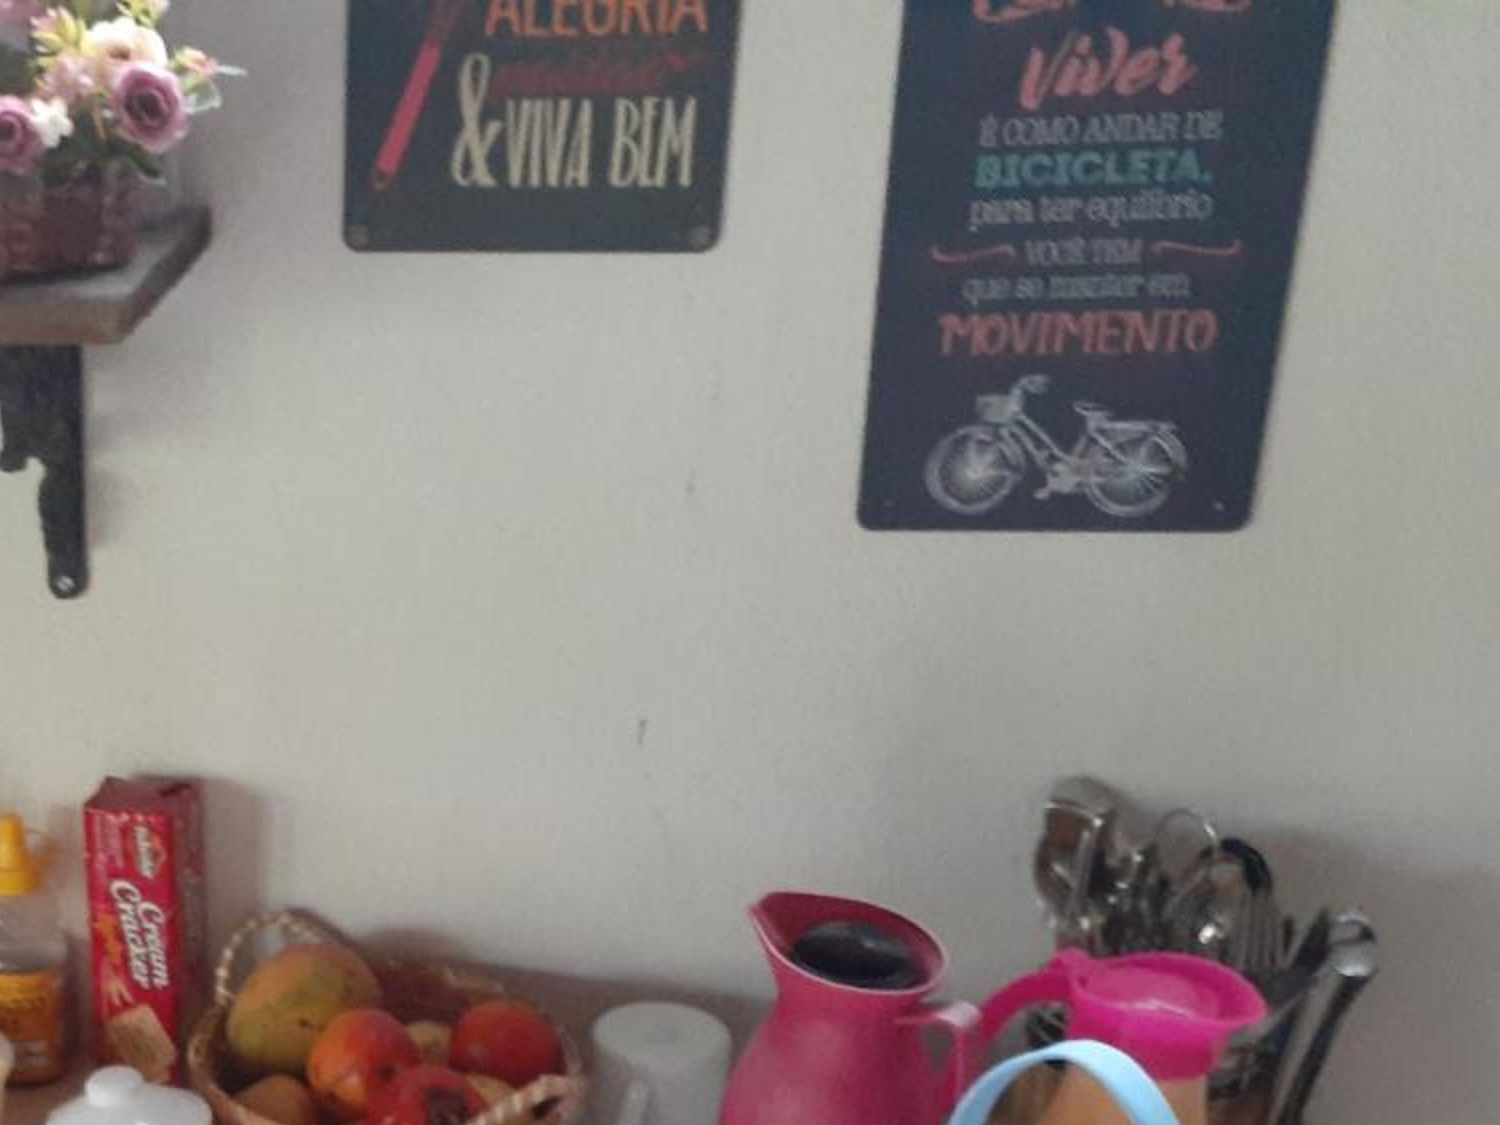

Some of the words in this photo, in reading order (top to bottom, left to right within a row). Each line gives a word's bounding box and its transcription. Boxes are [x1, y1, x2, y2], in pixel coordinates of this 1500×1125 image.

[484, 0, 709, 37] ALEGRIA
[1019, 26, 1198, 111] Viver
[506, 97, 593, 189] VIVA
[608, 96, 697, 189] BEM
[1001, 114, 1079, 146] COMO
[1083, 111, 1179, 144] ANDAR
[1184, 110, 1224, 141] DE
[938, 308, 1220, 356] MOVIMENTO
[109, 879, 151, 990] Cracker
[136, 900, 172, 991] Cream
